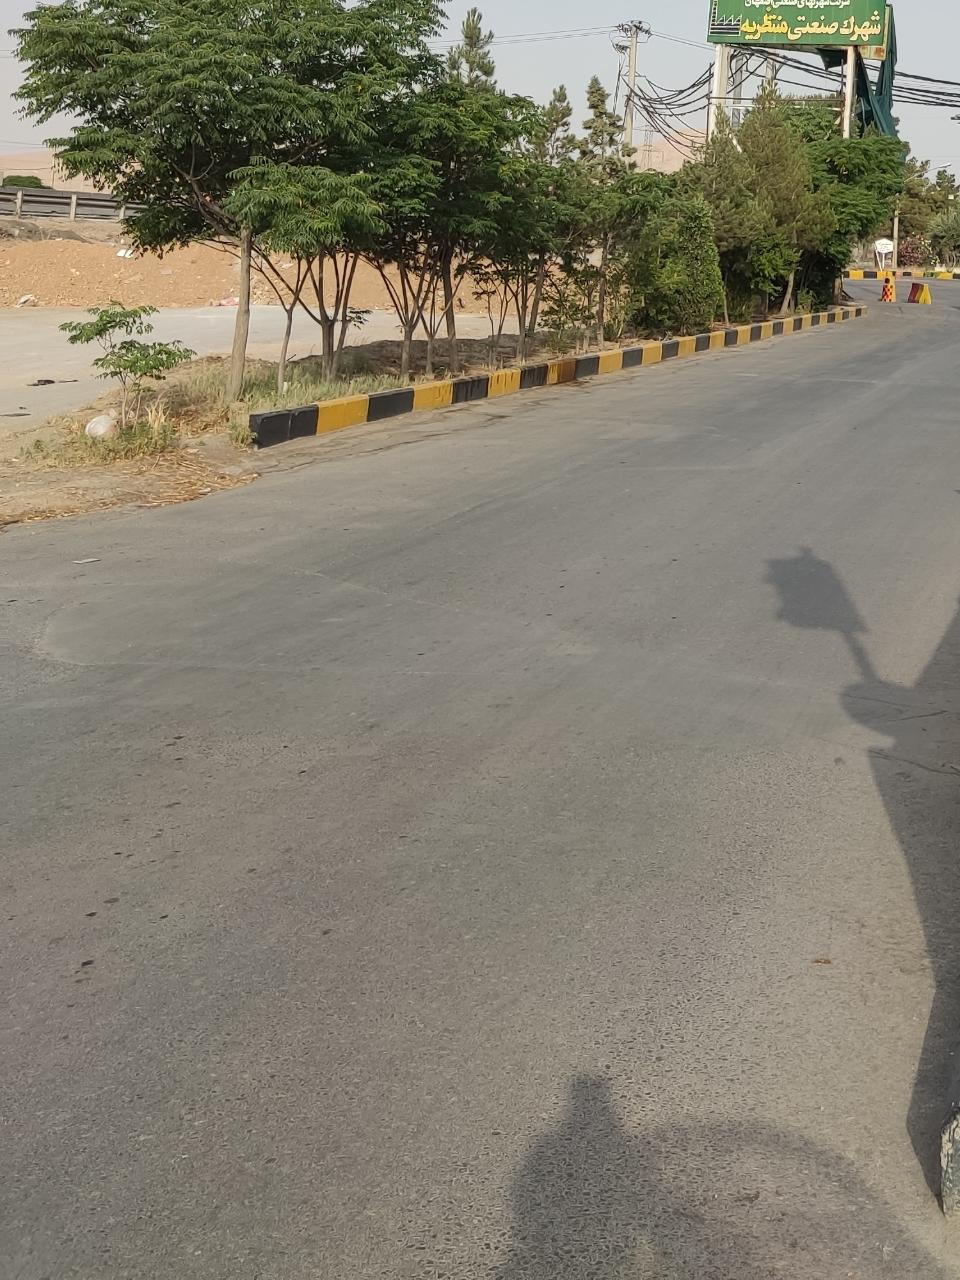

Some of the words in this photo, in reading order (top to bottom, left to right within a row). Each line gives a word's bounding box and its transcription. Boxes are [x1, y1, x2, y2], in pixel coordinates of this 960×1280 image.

[740, 7, 788, 40] منتظریه
[788, 15, 838, 40] صنعتی
[840, 10, 882, 41] شهرک
